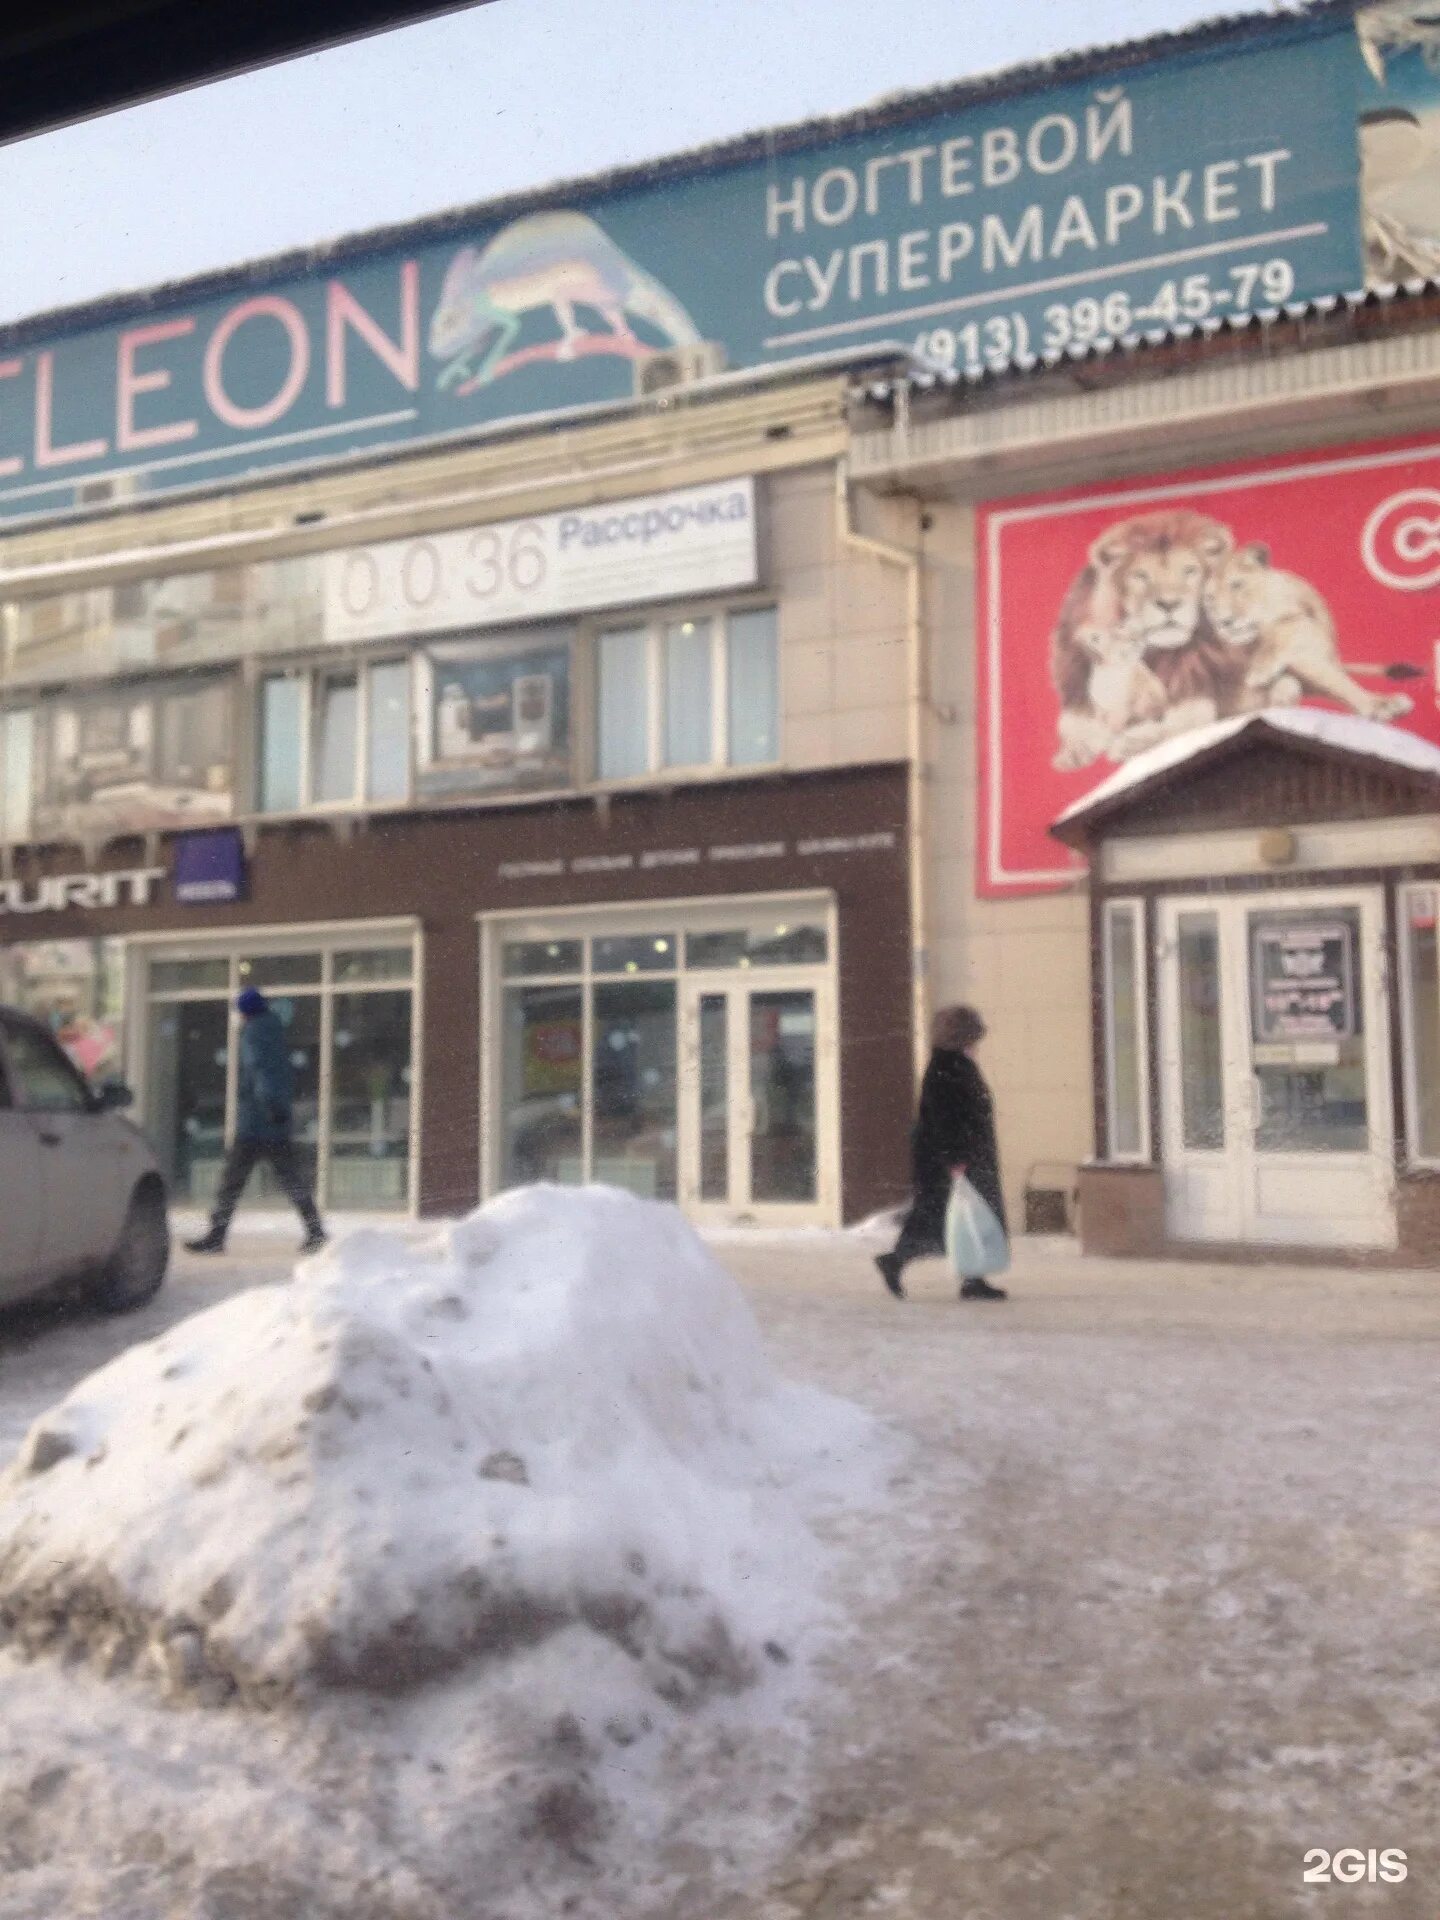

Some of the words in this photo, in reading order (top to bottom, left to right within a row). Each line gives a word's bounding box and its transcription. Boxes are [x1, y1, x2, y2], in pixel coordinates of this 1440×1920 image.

[764, 85, 1134, 237] НОГТЕВОЙ
[763, 149, 1292, 318] СУПЕРМАРКЕТ
[1043, 258, 1296, 350] 396-45-79
[557, 492, 748, 551] Рассрочка
